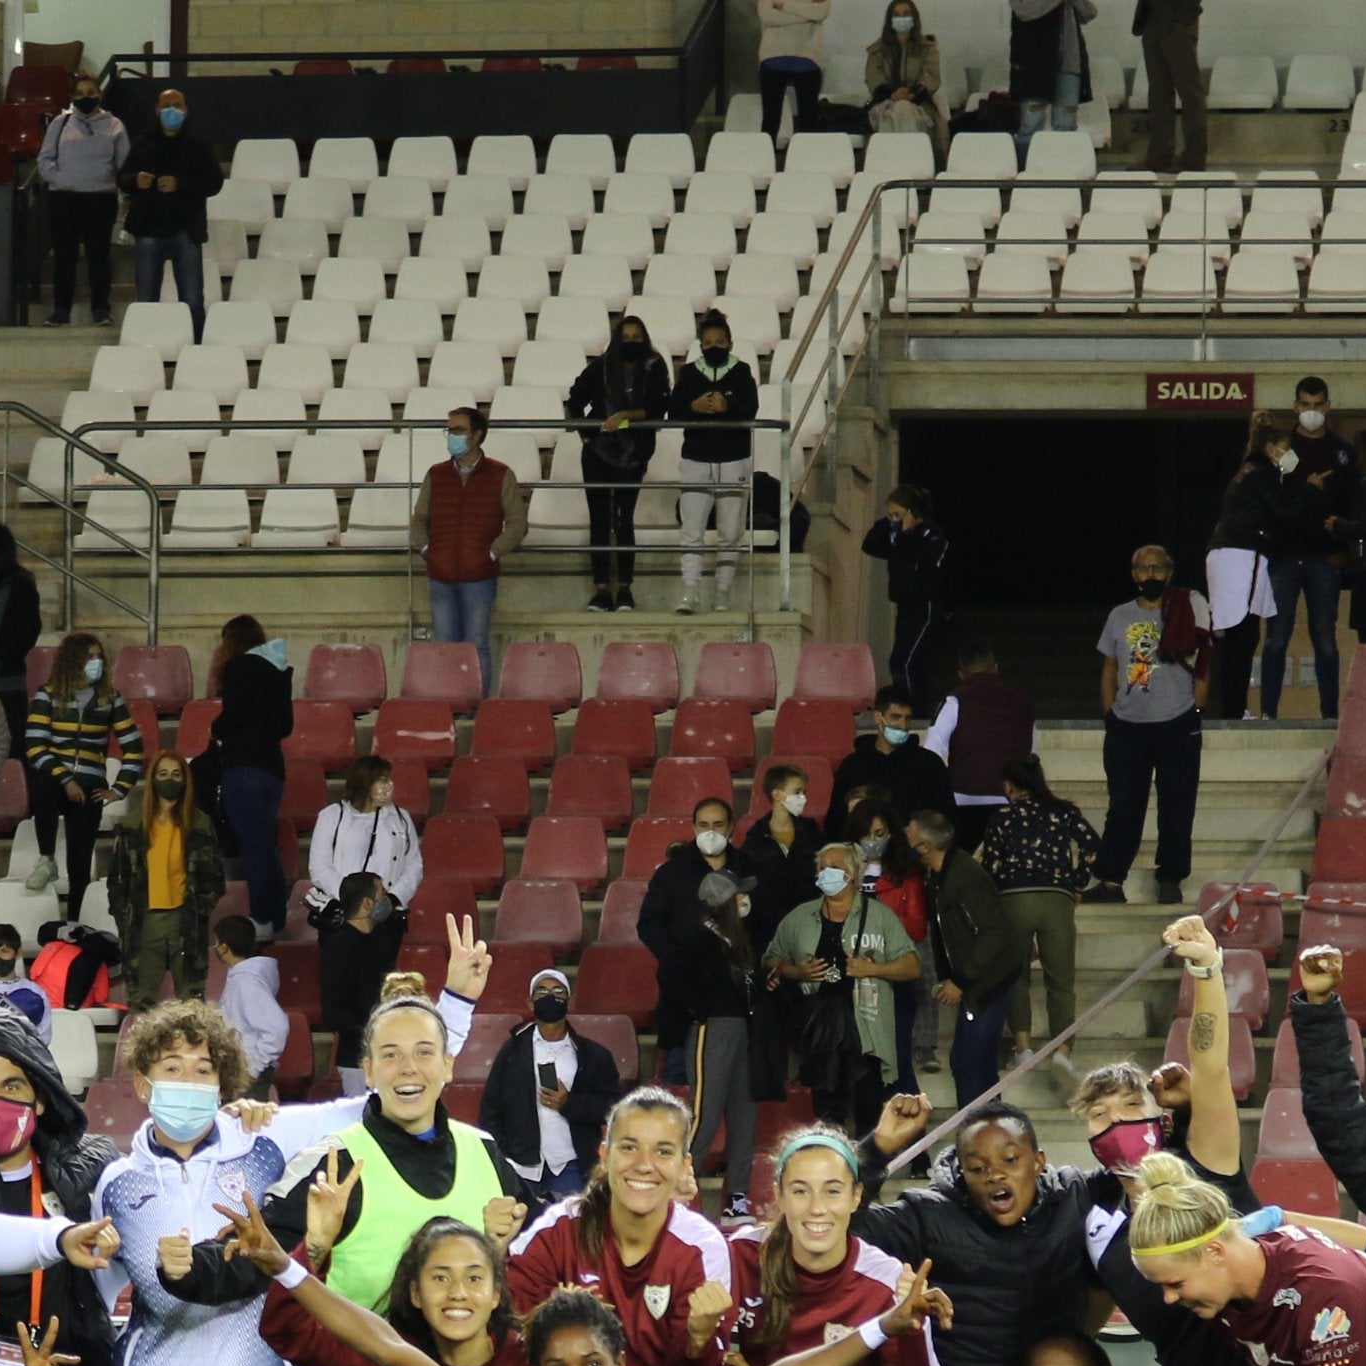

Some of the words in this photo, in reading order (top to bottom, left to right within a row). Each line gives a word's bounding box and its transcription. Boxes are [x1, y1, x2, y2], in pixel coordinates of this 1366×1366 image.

[1329, 119, 1350, 132] 23
[1157, 382, 1243, 400] SALIDA
[739, 1307, 755, 1328] 25
[1305, 1341, 1360, 1362] Bañaes
